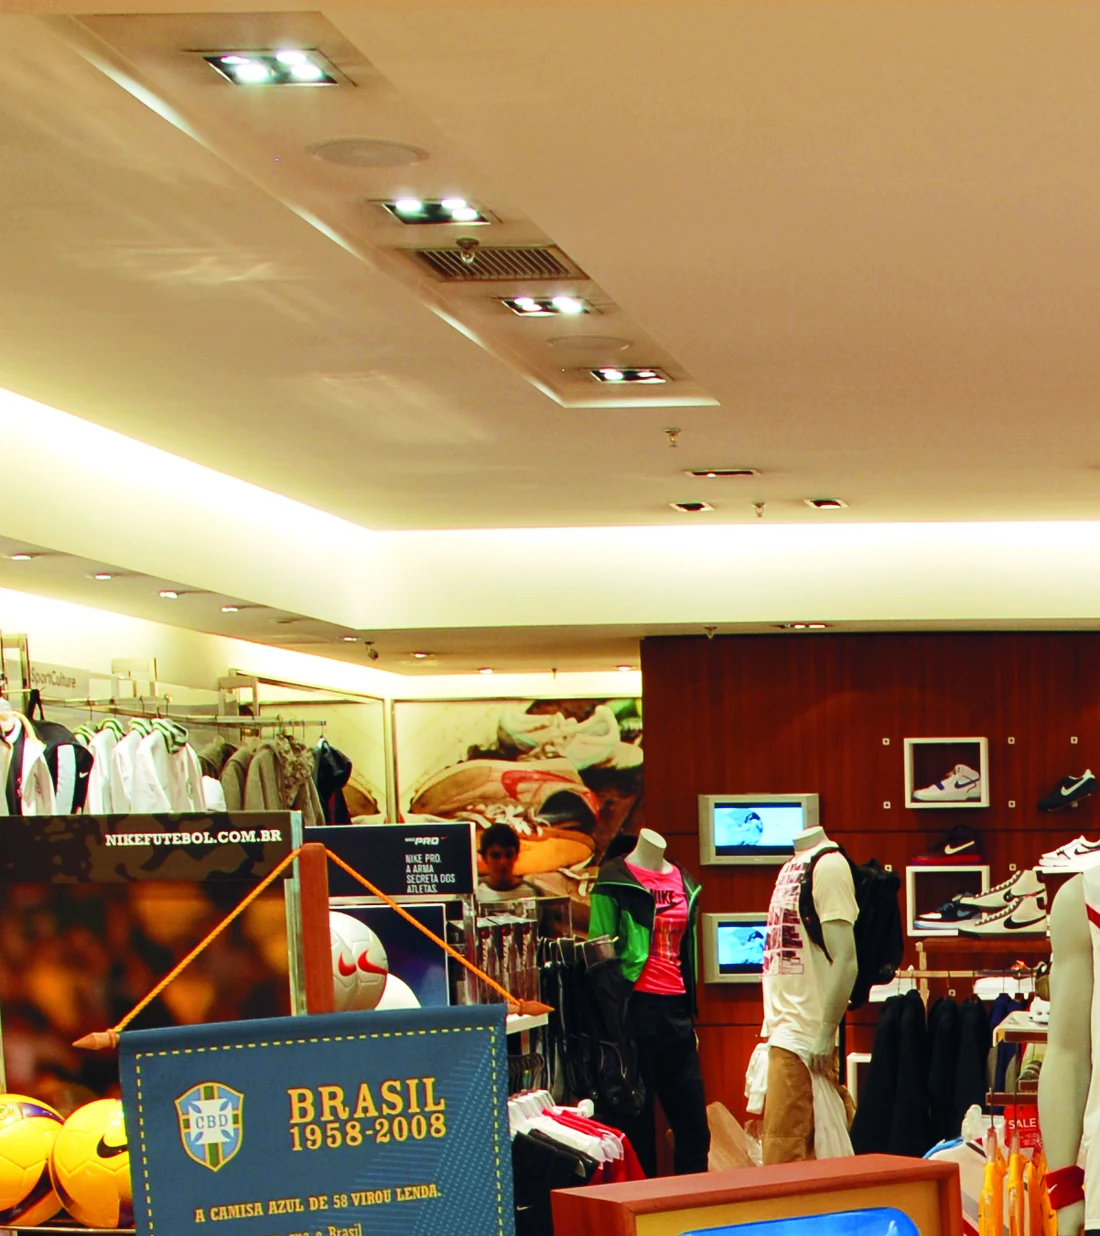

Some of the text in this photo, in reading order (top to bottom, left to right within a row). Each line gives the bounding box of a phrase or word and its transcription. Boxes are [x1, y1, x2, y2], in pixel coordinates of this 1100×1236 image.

[105, 829, 282, 846] NIKEFUTEBOL.COM.BR
[406, 865, 434, 873] A ARMA
[407, 874, 455, 884] SECRETA DOS
[287, 1077, 445, 1124] BRASIL
[195, 1113, 228, 1130] CBD
[1008, 1118, 1036, 1130] SALE
[289, 1112, 447, 1151] 1958-2008
[194, 1208, 205, 1223] A
[209, 1202, 264, 1220] CAMISA
[268, 1198, 304, 1214] AZUL
[308, 1194, 328, 1210] DE
[332, 1194, 348, 1208] 58
[350, 1189, 391, 1205] VIROU
